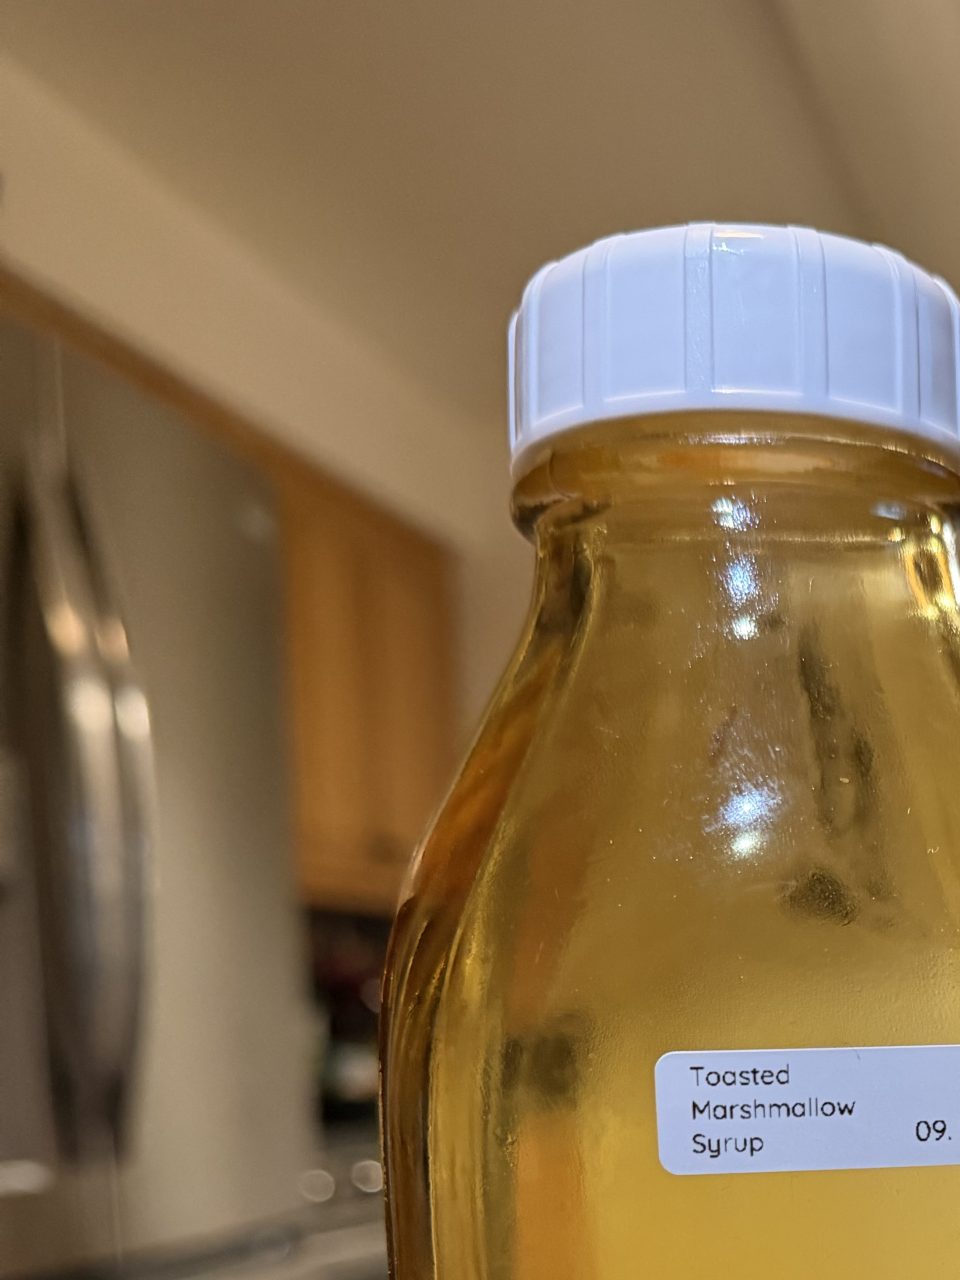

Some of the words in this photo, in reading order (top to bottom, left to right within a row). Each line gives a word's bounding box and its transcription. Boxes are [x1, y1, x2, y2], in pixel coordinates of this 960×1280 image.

[689, 1063, 790, 1087] Toasted
[691, 1097, 856, 1121] Marshmallow
[691, 1133, 764, 1159] Syrup
